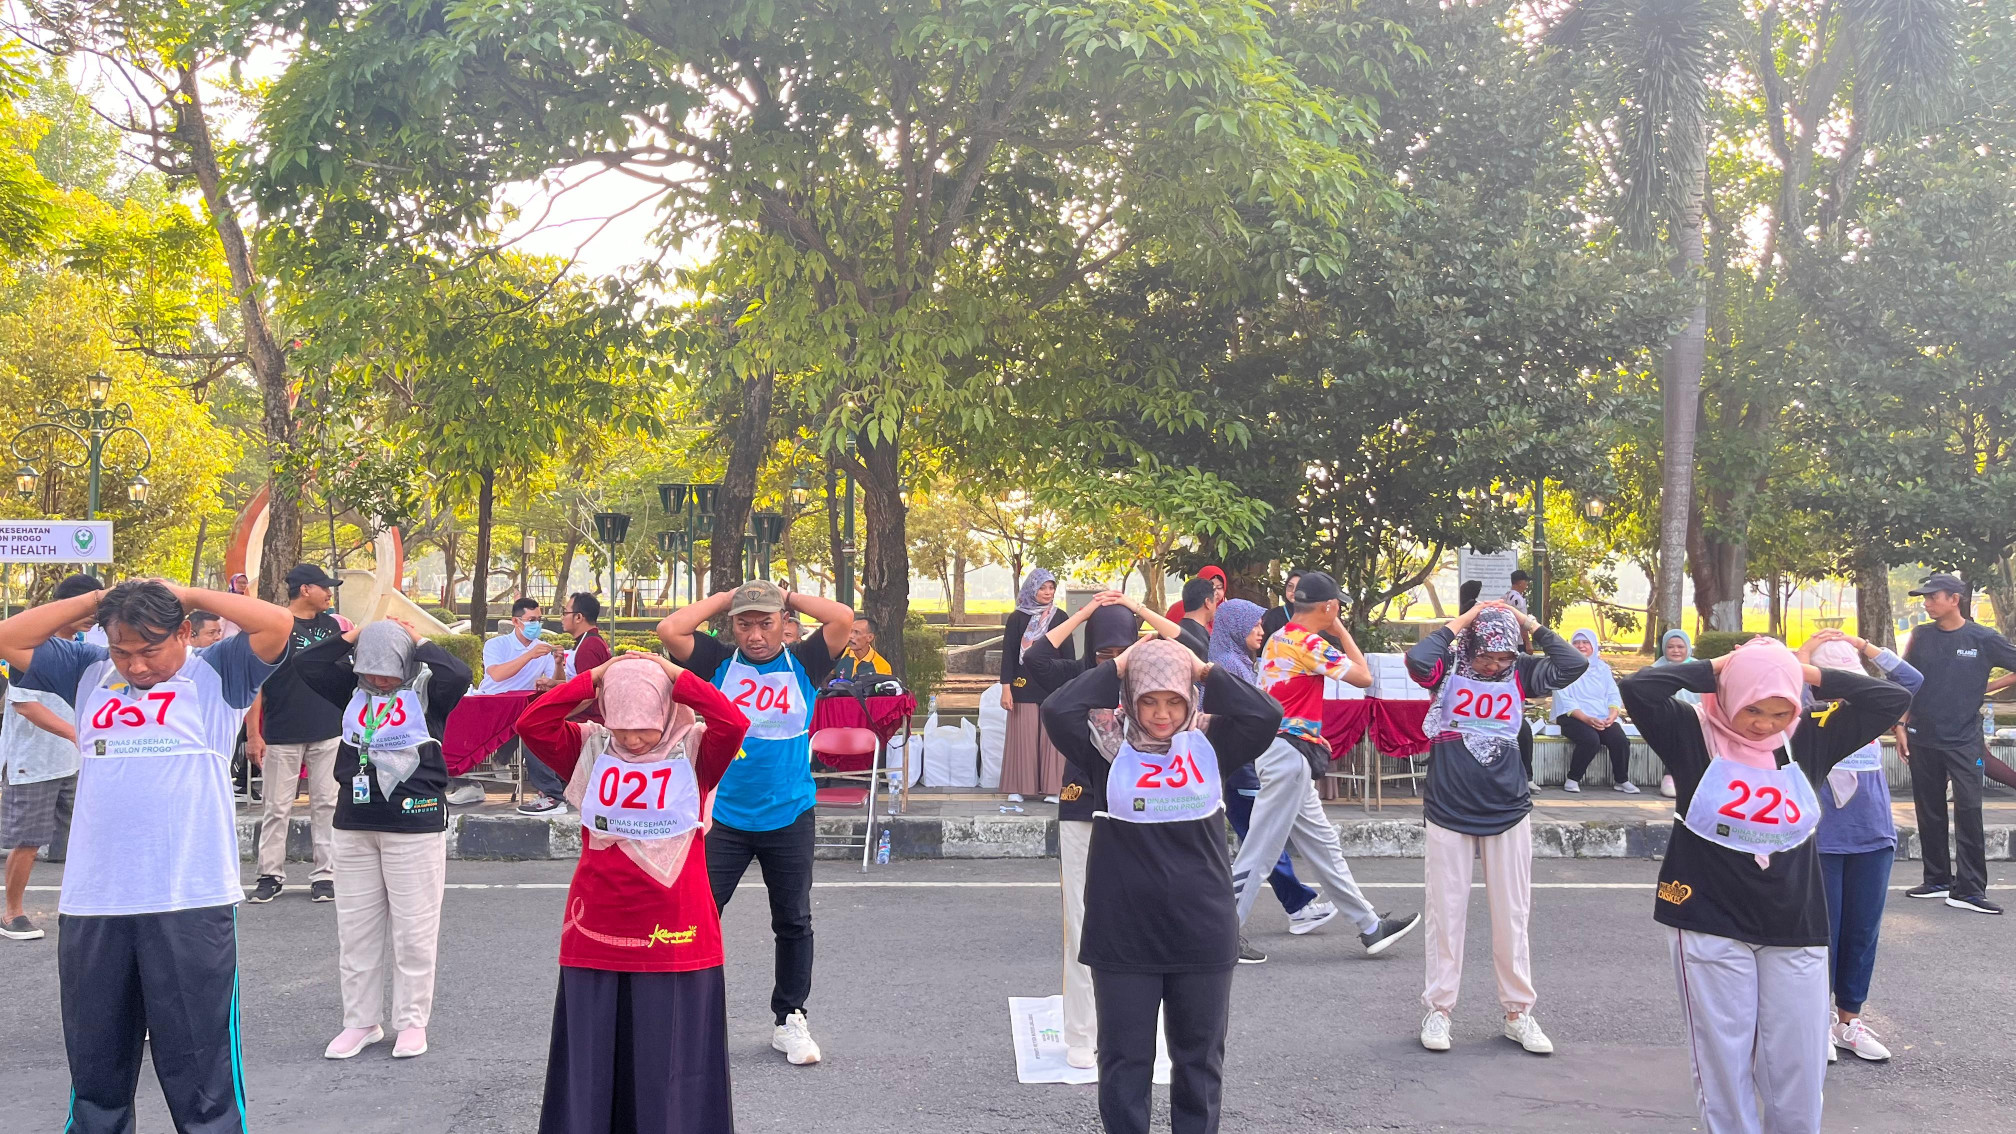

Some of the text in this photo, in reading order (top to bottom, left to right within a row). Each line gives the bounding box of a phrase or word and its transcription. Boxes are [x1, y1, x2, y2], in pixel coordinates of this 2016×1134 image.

[11, 545, 57, 555] HEALTH
[732, 678, 791, 715] 204
[1452, 688, 1513, 721] 202
[108, 738, 180, 747] DINAS KESEHATAN
[376, 733, 411, 743] KESEHATAN
[385, 739, 407, 748] PROGO
[113, 745, 172, 754] KULON PROGO
[1135, 748, 1205, 788] 231
[598, 766, 672, 810] 027
[1171, 793, 1210, 804] KESEHATAN
[1153, 801, 1206, 812] KULON PROGO
[609, 818, 677, 828] DINAS KESEHATAN
[616, 827, 671, 835] KULON PROGO
[1732, 827, 1757, 837] DINAS
[1738, 834, 1767, 844] KULON
